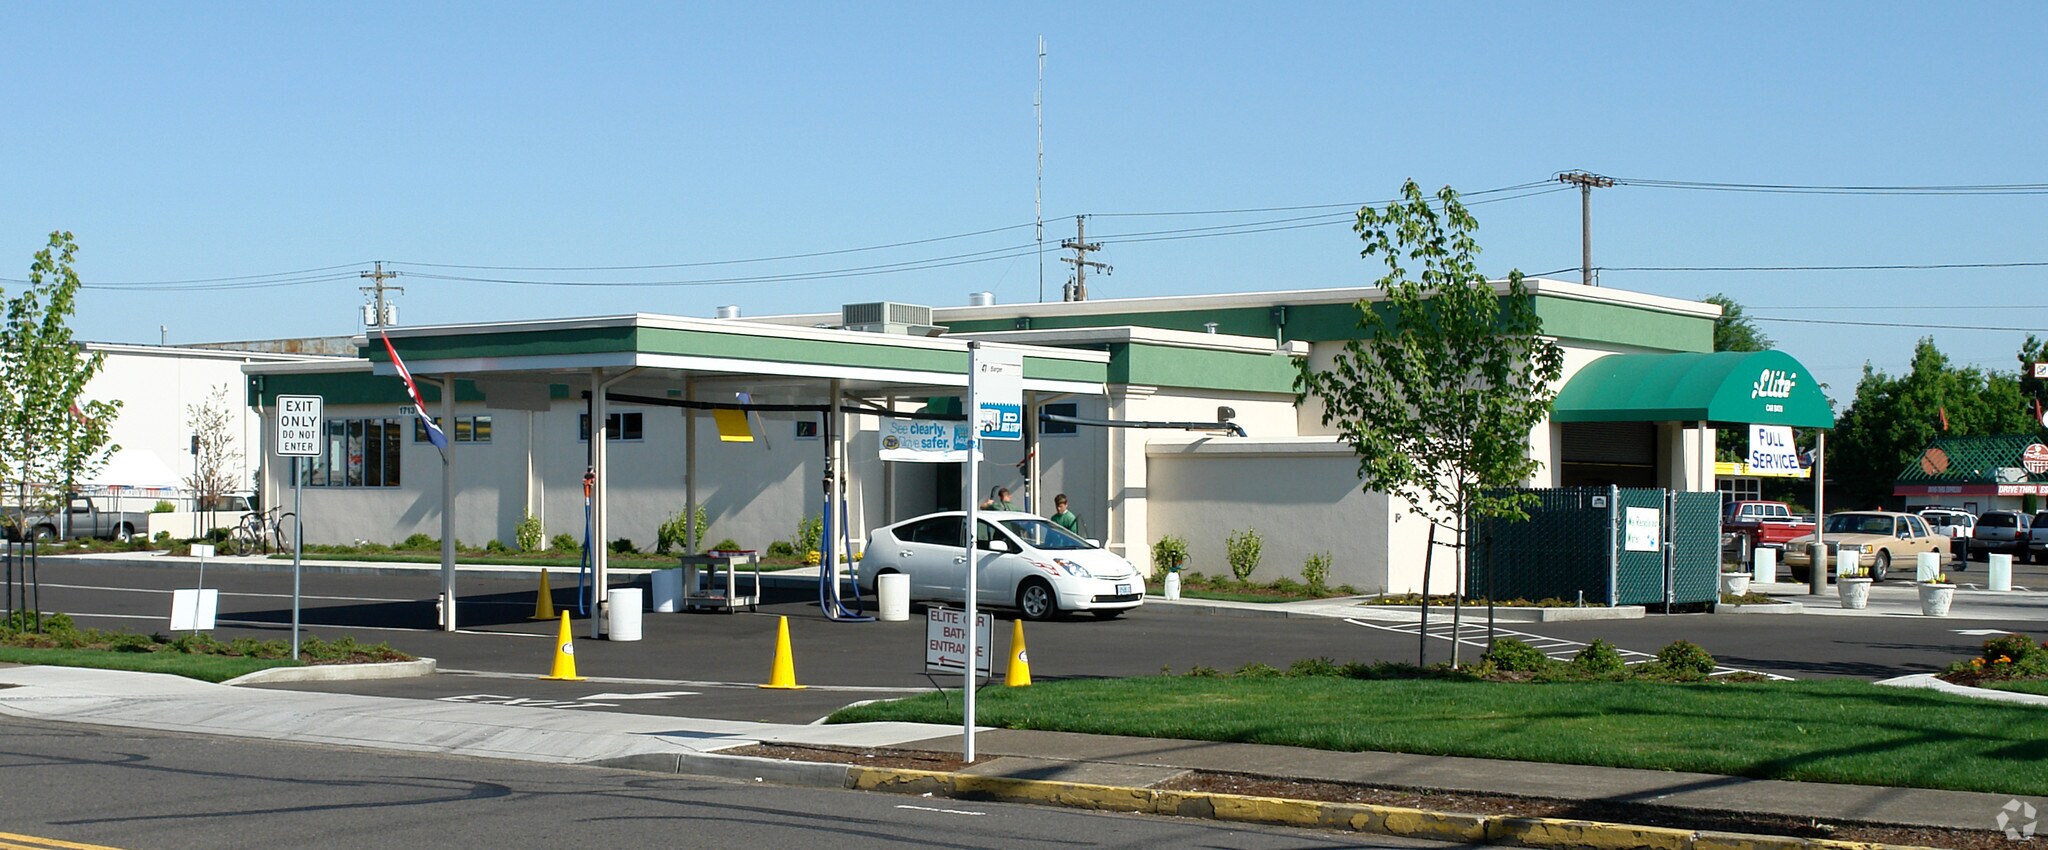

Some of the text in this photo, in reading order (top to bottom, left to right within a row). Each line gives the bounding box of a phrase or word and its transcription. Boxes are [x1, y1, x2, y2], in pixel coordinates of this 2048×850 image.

[1758, 368, 1791, 399] Elite
[286, 400, 313, 412] EXIT
[400, 406, 415, 415] 1713
[281, 415, 317, 427] ONLY
[282, 430, 315, 439] DO NOT
[890, 421, 908, 435] See
[910, 422, 946, 438] clearly.
[921, 436, 950, 449] safer.
[1759, 428, 1784, 447] FULL
[284, 442, 314, 451] ENTER
[1752, 450, 1798, 469] SERVICE
[1998, 485, 2018, 494] DRIVE
[2019, 485, 2036, 494] THRU
[931, 610, 958, 624] ELITE
